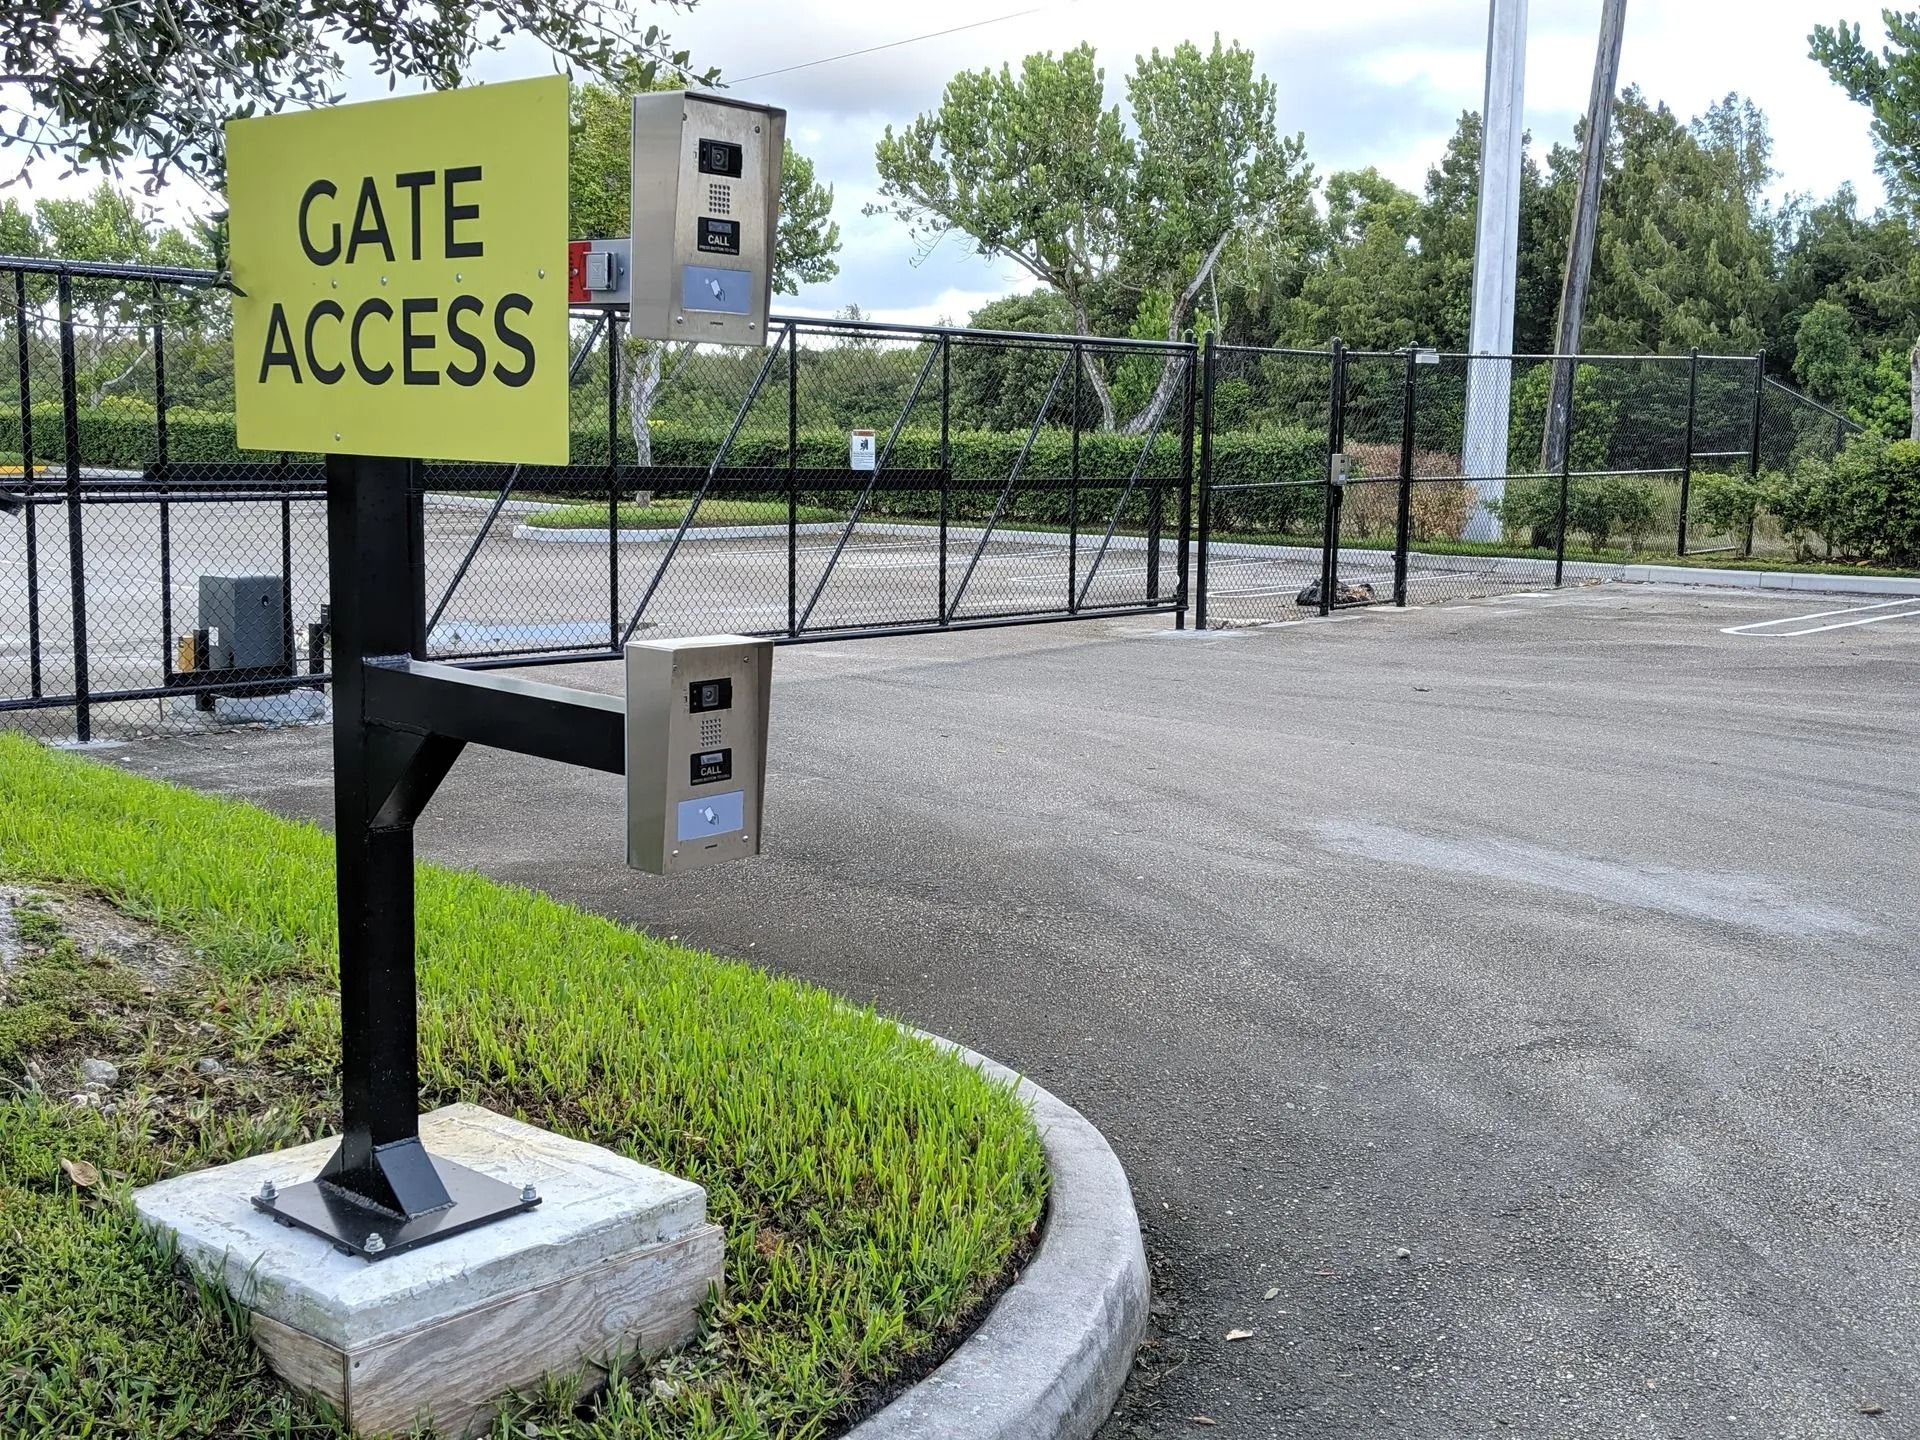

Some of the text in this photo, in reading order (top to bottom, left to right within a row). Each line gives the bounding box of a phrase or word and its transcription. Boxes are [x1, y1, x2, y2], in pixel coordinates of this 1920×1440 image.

[298, 165, 484, 266] GATE
[708, 234, 730, 246] CALL
[258, 293, 536, 388] ACCESS
[701, 765, 722, 776] CALL
